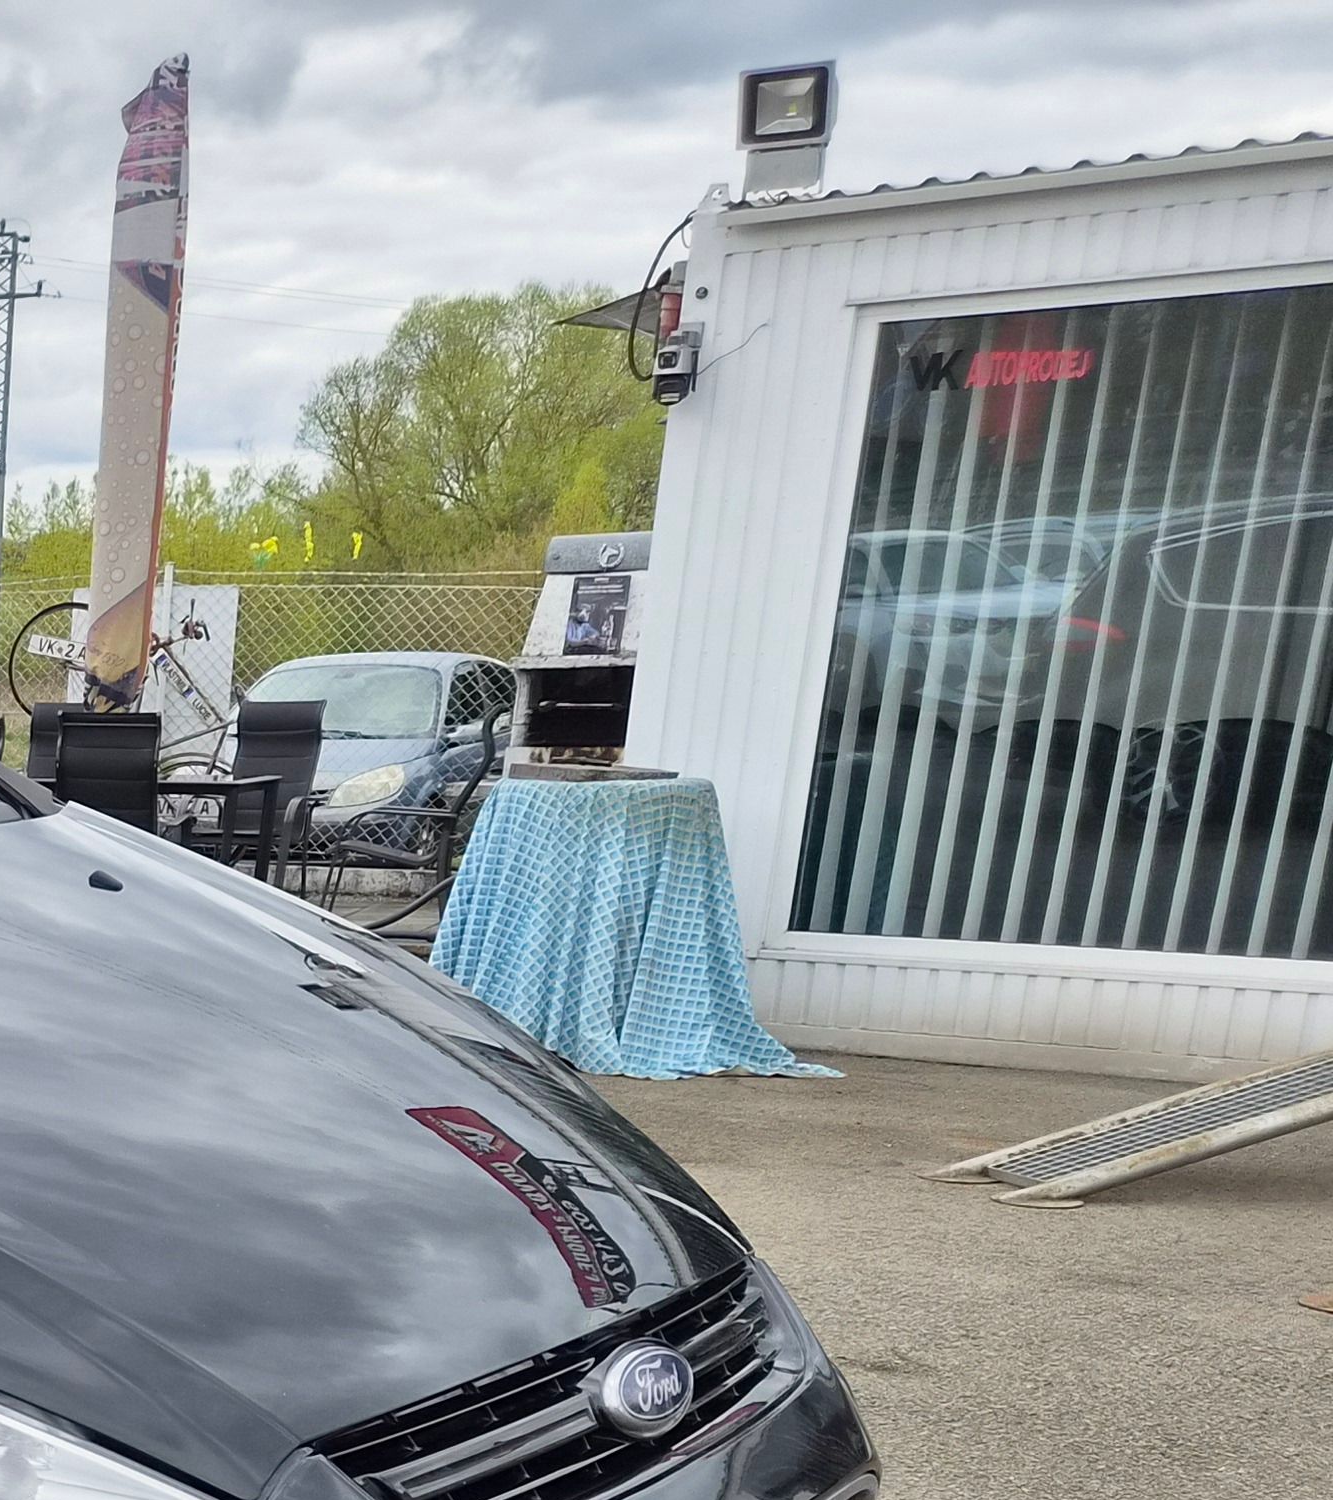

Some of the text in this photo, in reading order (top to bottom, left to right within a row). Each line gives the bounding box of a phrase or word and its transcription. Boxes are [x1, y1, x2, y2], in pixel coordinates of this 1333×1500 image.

[909, 350, 1096, 391] VK AUTOPRODEJ
[39, 637, 58, 655] VK
[64, 643, 75, 658] 2
[192, 698, 212, 721] LUCIE
[635, 1357, 683, 1412] Ford
